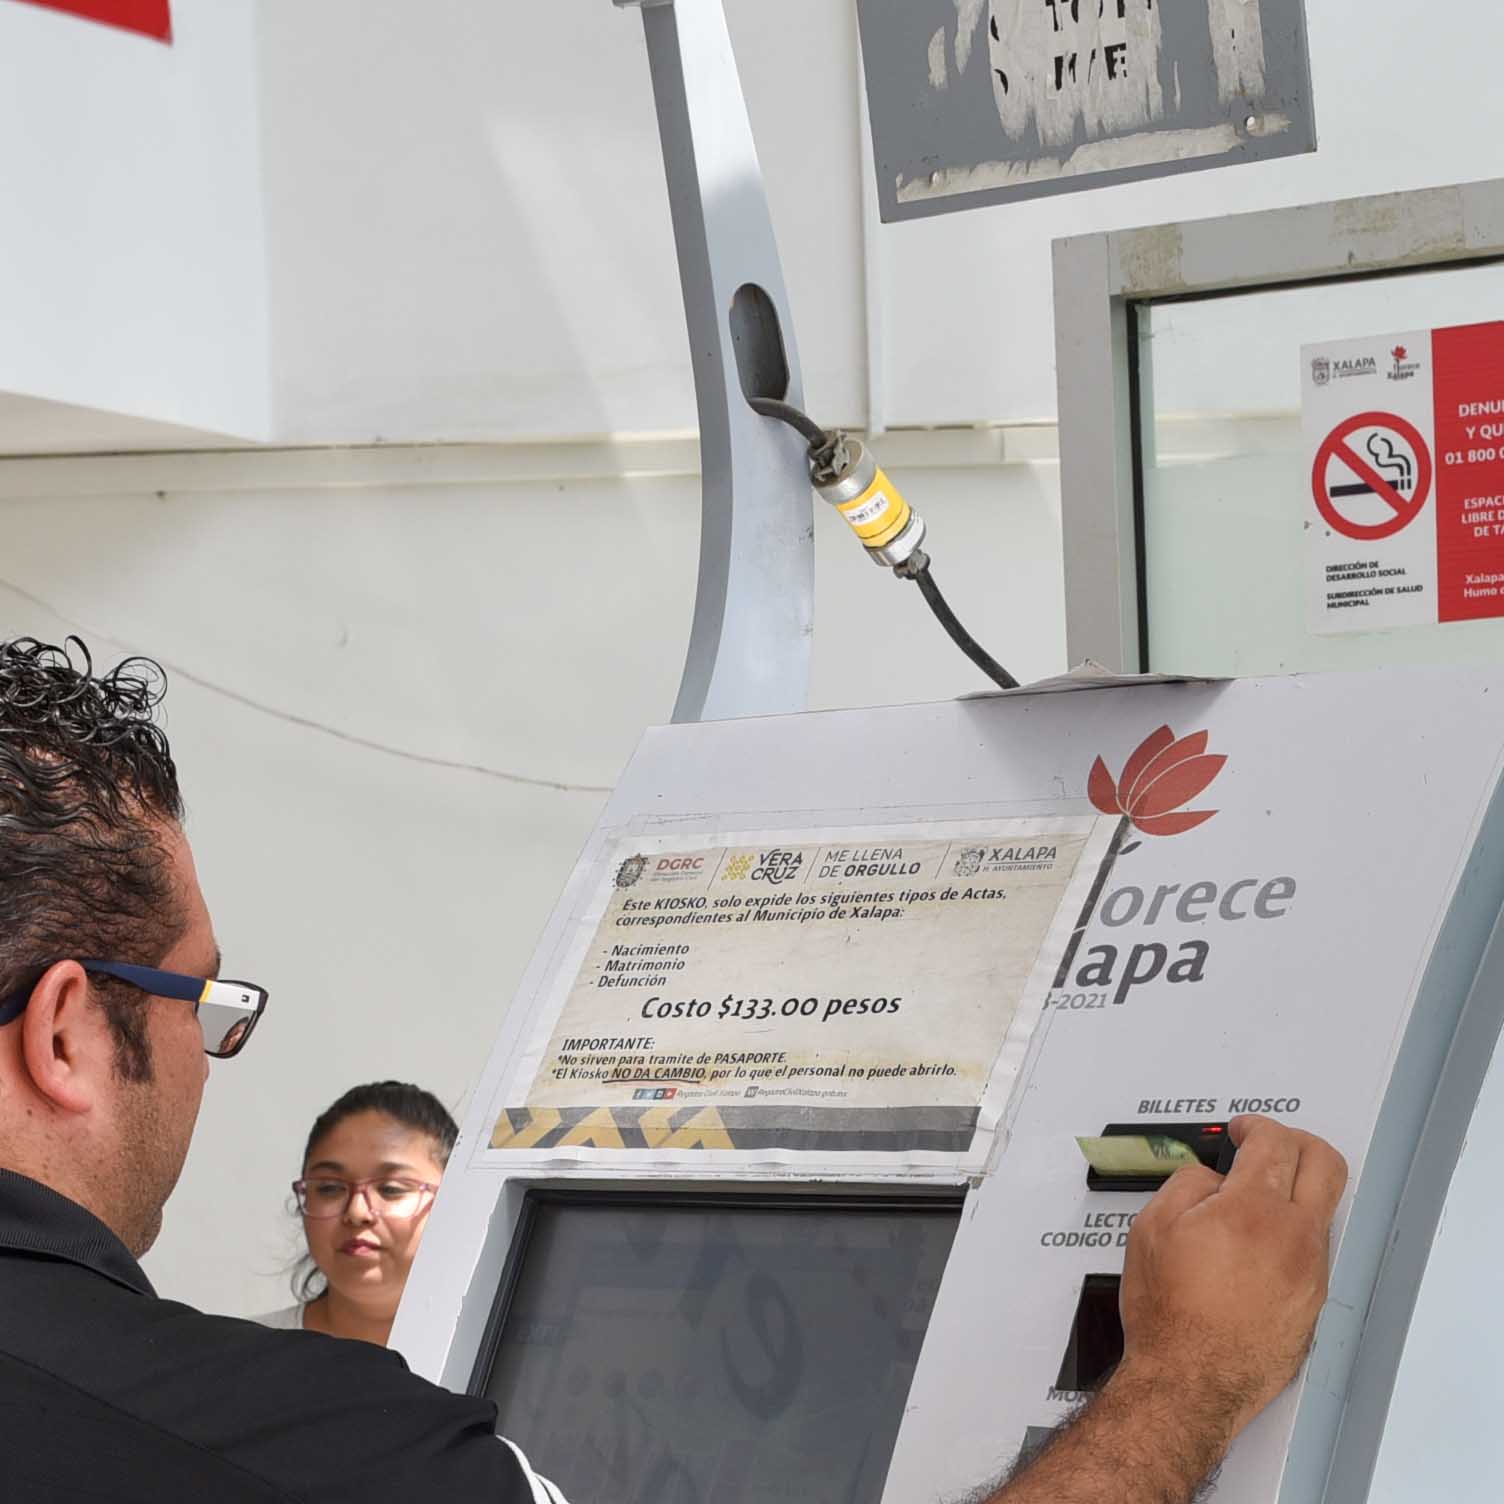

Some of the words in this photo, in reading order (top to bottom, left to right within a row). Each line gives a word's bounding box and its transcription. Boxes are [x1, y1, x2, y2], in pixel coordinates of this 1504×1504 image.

[1333, 357, 1375, 370] XALAPA
[1465, 427, 1476, 439] Y
[1445, 452, 1463, 464] 01
[1467, 449, 1495, 461] 800
[1462, 511, 1494, 524] LIBRE
[1474, 524, 1489, 537] DE
[1465, 571, 1504, 587] Xalapa
[1464, 584, 1497, 598] Humo
[656, 858, 704, 871] DGRC
[760, 849, 802, 865] VERA
[989, 846, 1056, 861] XALAPA
[751, 866, 799, 884] CRUZ
[844, 862, 920, 876] ORGULLO
[623, 900, 651, 911] Este
[712, 896, 741, 908] solo
[745, 893, 792, 910] expide
[795, 892, 816, 905] los
[820, 890, 894, 907] siguientes
[899, 889, 936, 904] tipos
[940, 887, 958, 900] de
[616, 913, 732, 928] correspondientes
[736, 911, 749, 922] al
[753, 907, 825, 922] Municipio
[829, 907, 846, 919] de
[850, 905, 904, 920] Xalapa:
[611, 944, 689, 956] Nacimiento
[605, 959, 685, 972] Matrimonio
[1052, 927, 1210, 1005] lapa
[598, 975, 666, 988] Defunción
[641, 997, 711, 1018] Costo
[718, 994, 818, 1020] $133.00
[822, 997, 903, 1022] pesos
[562, 1037, 655, 1051] IMPORTANTE:
[580, 1053, 615, 1065] sirven
[618, 1055, 644, 1067] para
[649, 1053, 694, 1064] tramite
[696, 1053, 711, 1064] de
[570, 1068, 608, 1079] Kiosko
[611, 1068, 631, 1078] NO
[633, 1068, 649, 1078] DA
[711, 1069, 731, 1080] por
[734, 1067, 746, 1078] lo
[749, 1068, 772, 1080] que
[775, 1066, 786, 1077] el
[788, 1064, 845, 1080] personal
[848, 1067, 864, 1077] no
[866, 1065, 906, 1080] puede
[909, 1064, 957, 1076] abrirlo.
[1138, 1099, 1216, 1114] BILLETES
[1228, 1098, 1300, 1112] KIOSCO
[1084, 1213, 1139, 1228] LECTO
[1041, 1232, 1112, 1247] CODIGO
